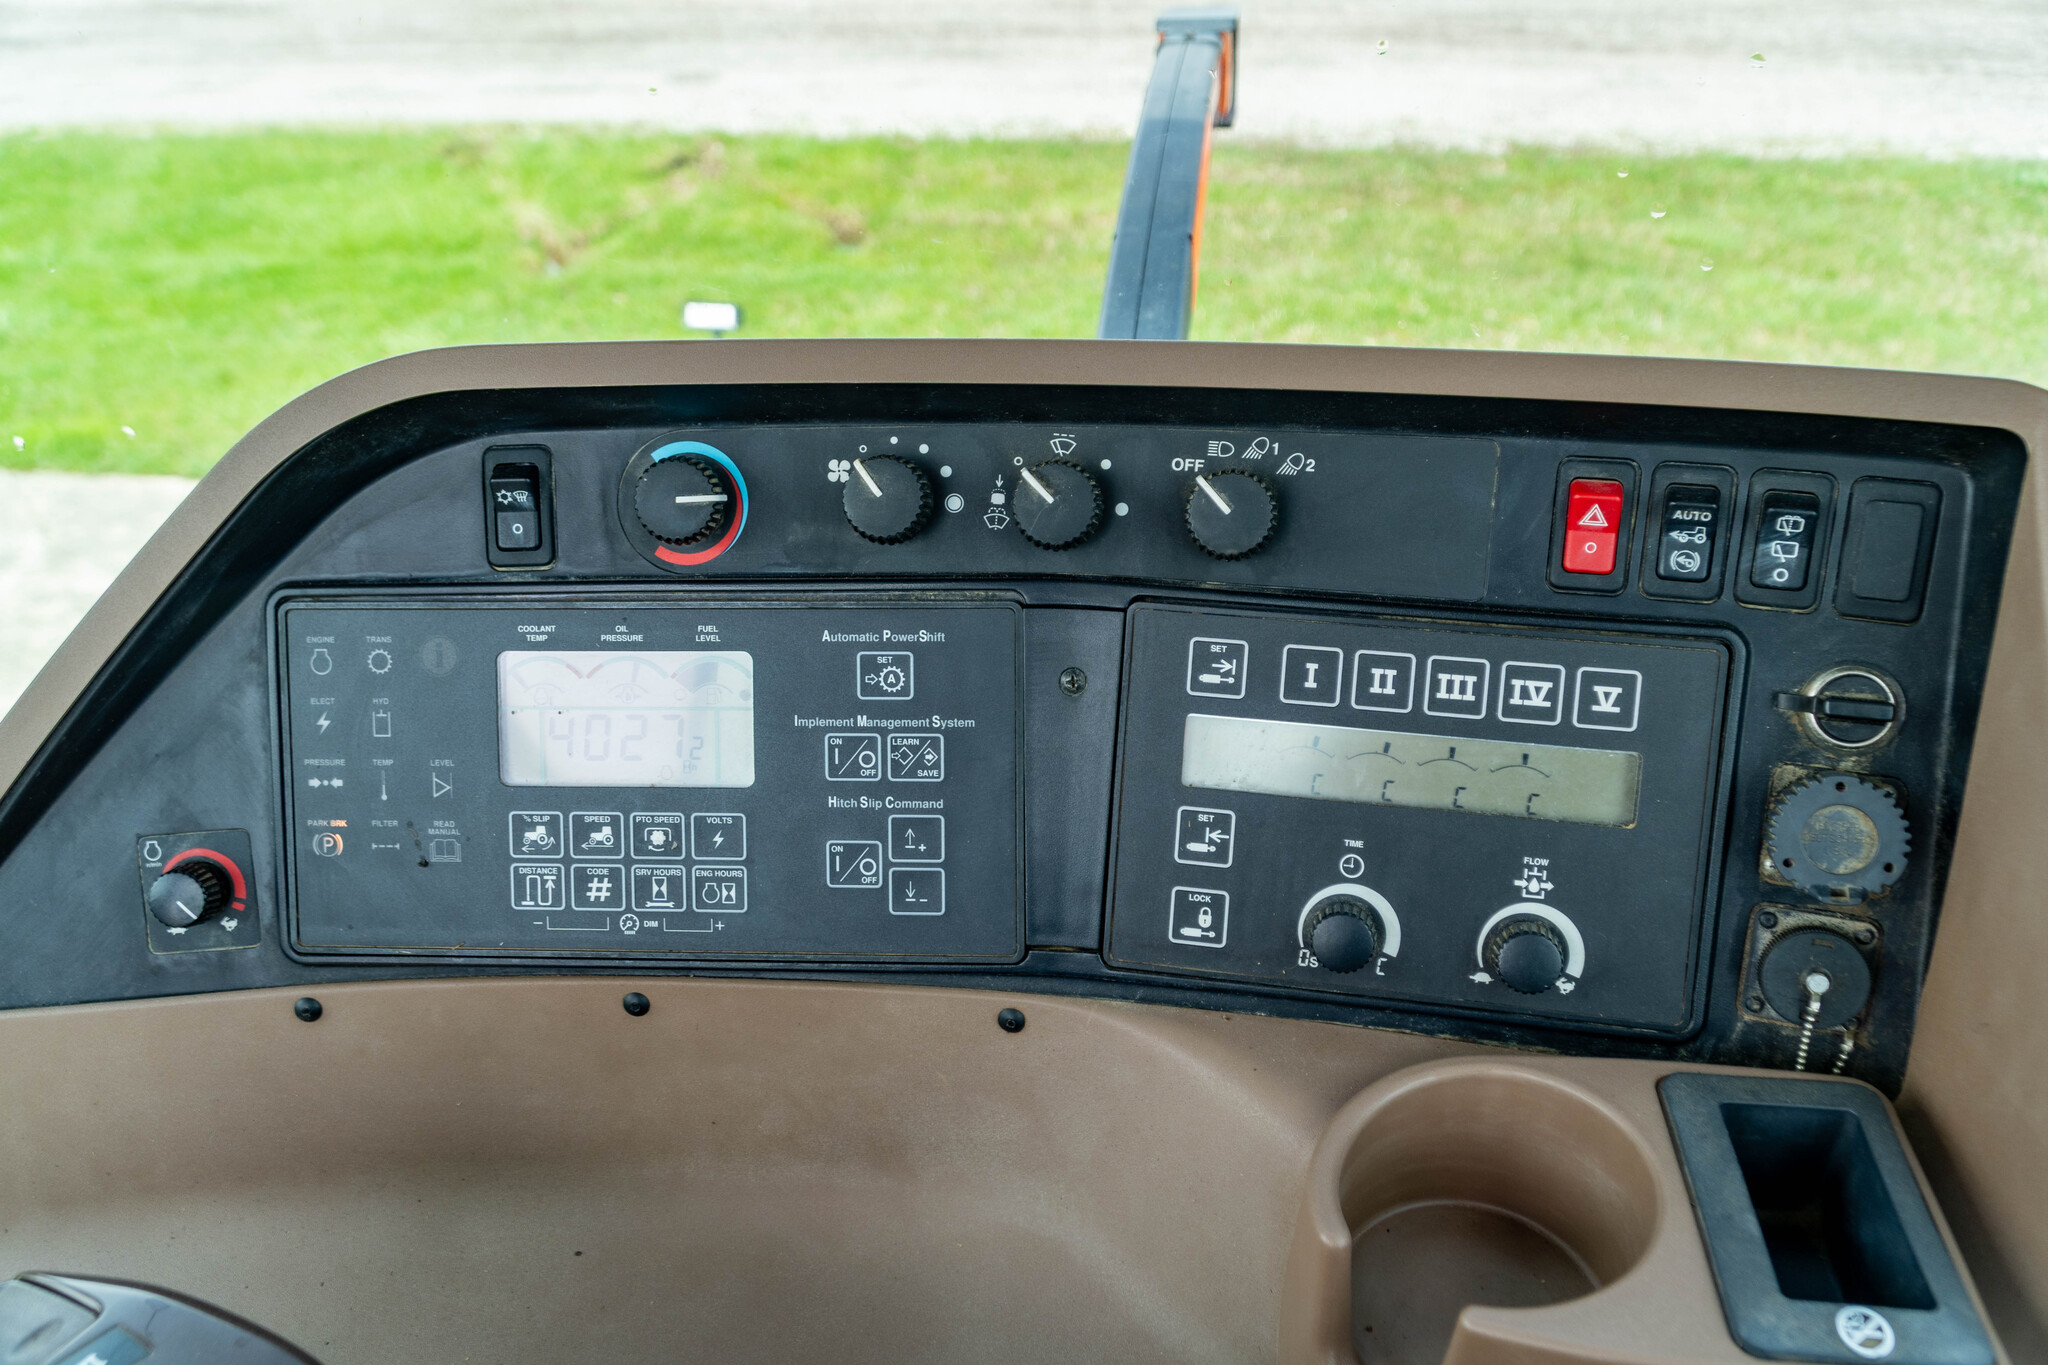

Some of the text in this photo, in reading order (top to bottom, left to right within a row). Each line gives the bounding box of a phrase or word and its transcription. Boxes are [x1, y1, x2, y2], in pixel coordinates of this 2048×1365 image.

[1271, 442, 1279, 456] 1
[1171, 457, 1206, 473] OFF
[1305, 458, 1316, 473] 2
[1672, 509, 1713, 522] AUTO
[517, 625, 557, 633] COOLANT
[614, 625, 629, 633] OIL
[697, 625, 719, 633] FUEL
[305, 635, 335, 644] ENGINE
[365, 635, 393, 644] TRANS
[525, 634, 549, 642] TEMP
[600, 634, 644, 642] PRESSURE
[695, 634, 722, 642] LEVEL
[821, 629, 946, 643] Automatic PowerShift
[1210, 644, 1228, 653] SET
[876, 656, 893, 664] SET
[1435, 672, 1478, 702] III
[1509, 678, 1554, 708] IV
[309, 697, 336, 706] ELECT
[372, 697, 390, 705] HYD
[1591, 685, 1623, 714] V
[794, 714, 976, 730] Implement Management System
[550, 714, 685, 761] 4027
[829, 737, 843, 746] ON
[891, 737, 920, 747] LEARN
[303, 758, 346, 767] PRESSURE
[372, 758, 394, 767] TEMP
[430, 759, 455, 767] LEVEL
[860, 768, 877, 777] OFF
[917, 769, 939, 777] SAVE
[828, 795, 944, 811] Hitch Slip Command
[522, 814, 551, 823] % SLIP
[583, 814, 611, 824] SPEED
[635, 815, 681, 825] PTO SPEED
[706, 816, 733, 825] VOLTS
[1197, 813, 1215, 823] SET
[307, 819, 348, 828] PARK BRK
[371, 819, 399, 828] FILTER
[433, 820, 456, 828] READ
[427, 828, 461, 836] MANUAL
[322, 837, 334, 853] P
[1343, 839, 1365, 849] TIME
[830, 845, 844, 853] ON
[1523, 856, 1550, 867] FLOW
[518, 866, 558, 875] DISTANCE
[586, 867, 610, 876] CODE
[635, 868, 682, 877] SRV HOURS
[695, 869, 743, 878] ENG HOURS
[861, 876, 877, 884] OFF
[1188, 893, 1212, 904] LOCK
[643, 920, 659, 928] DIM
